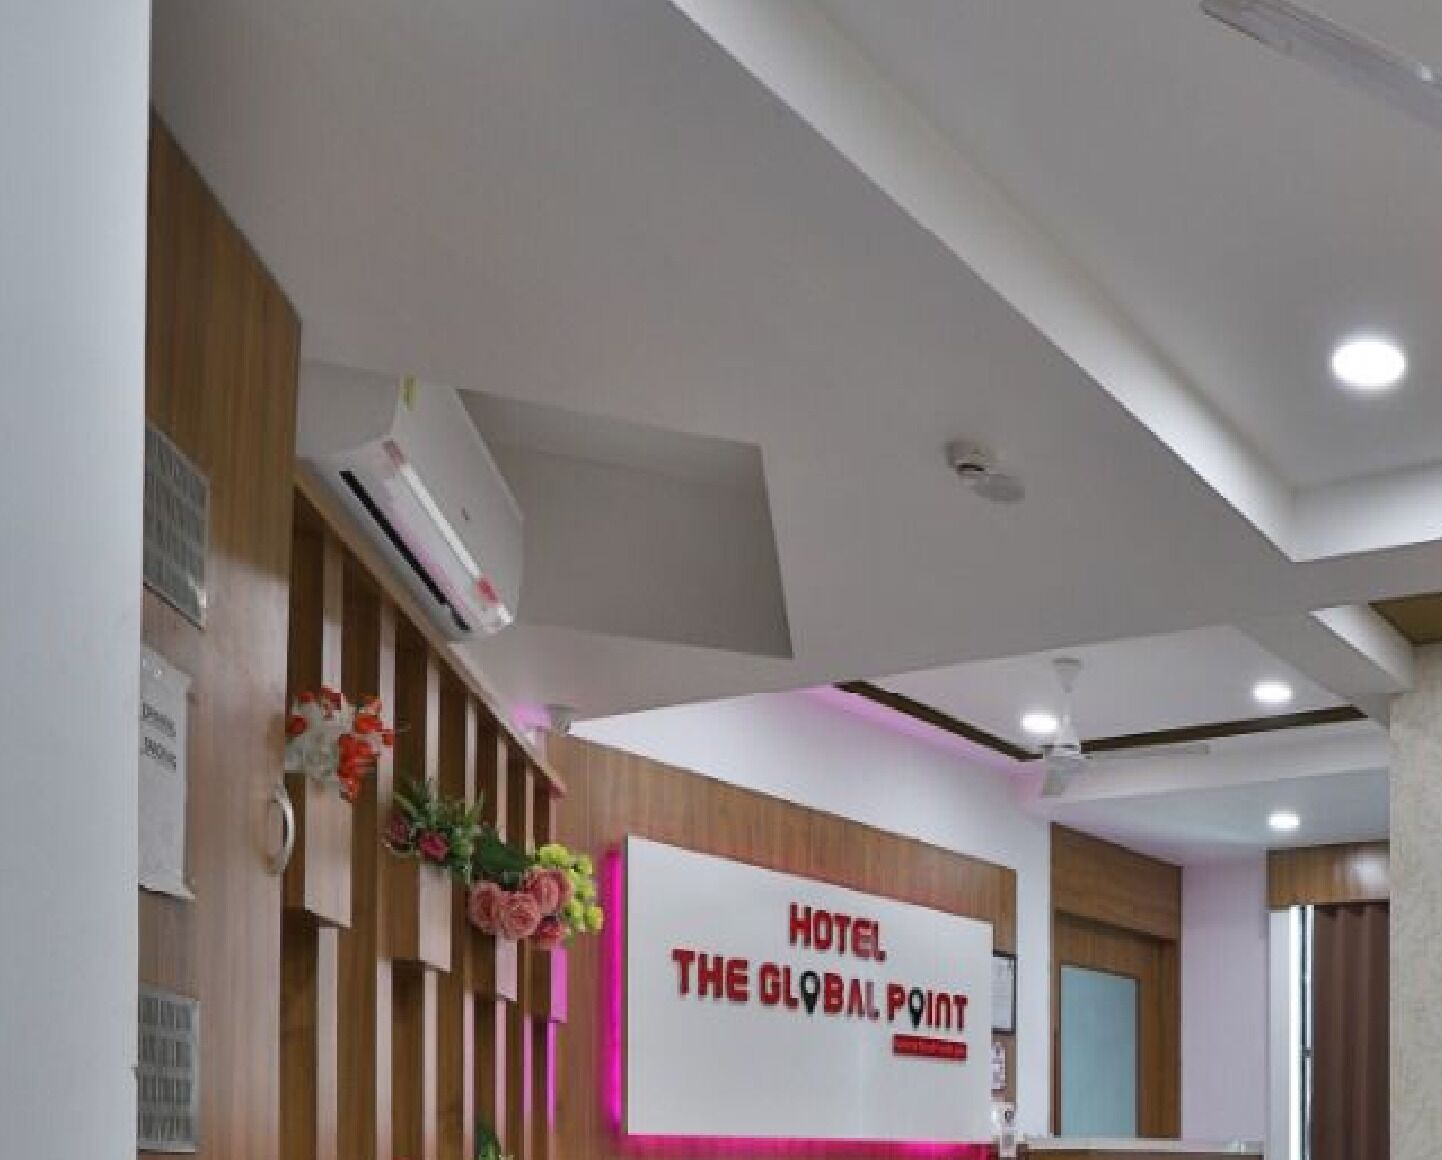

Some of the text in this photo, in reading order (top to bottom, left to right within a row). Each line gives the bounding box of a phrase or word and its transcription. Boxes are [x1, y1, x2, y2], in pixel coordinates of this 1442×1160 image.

[789, 901, 887, 962] HOTEL
[672, 948, 749, 1001] THE
[758, 961, 880, 1020] GLOBAL
